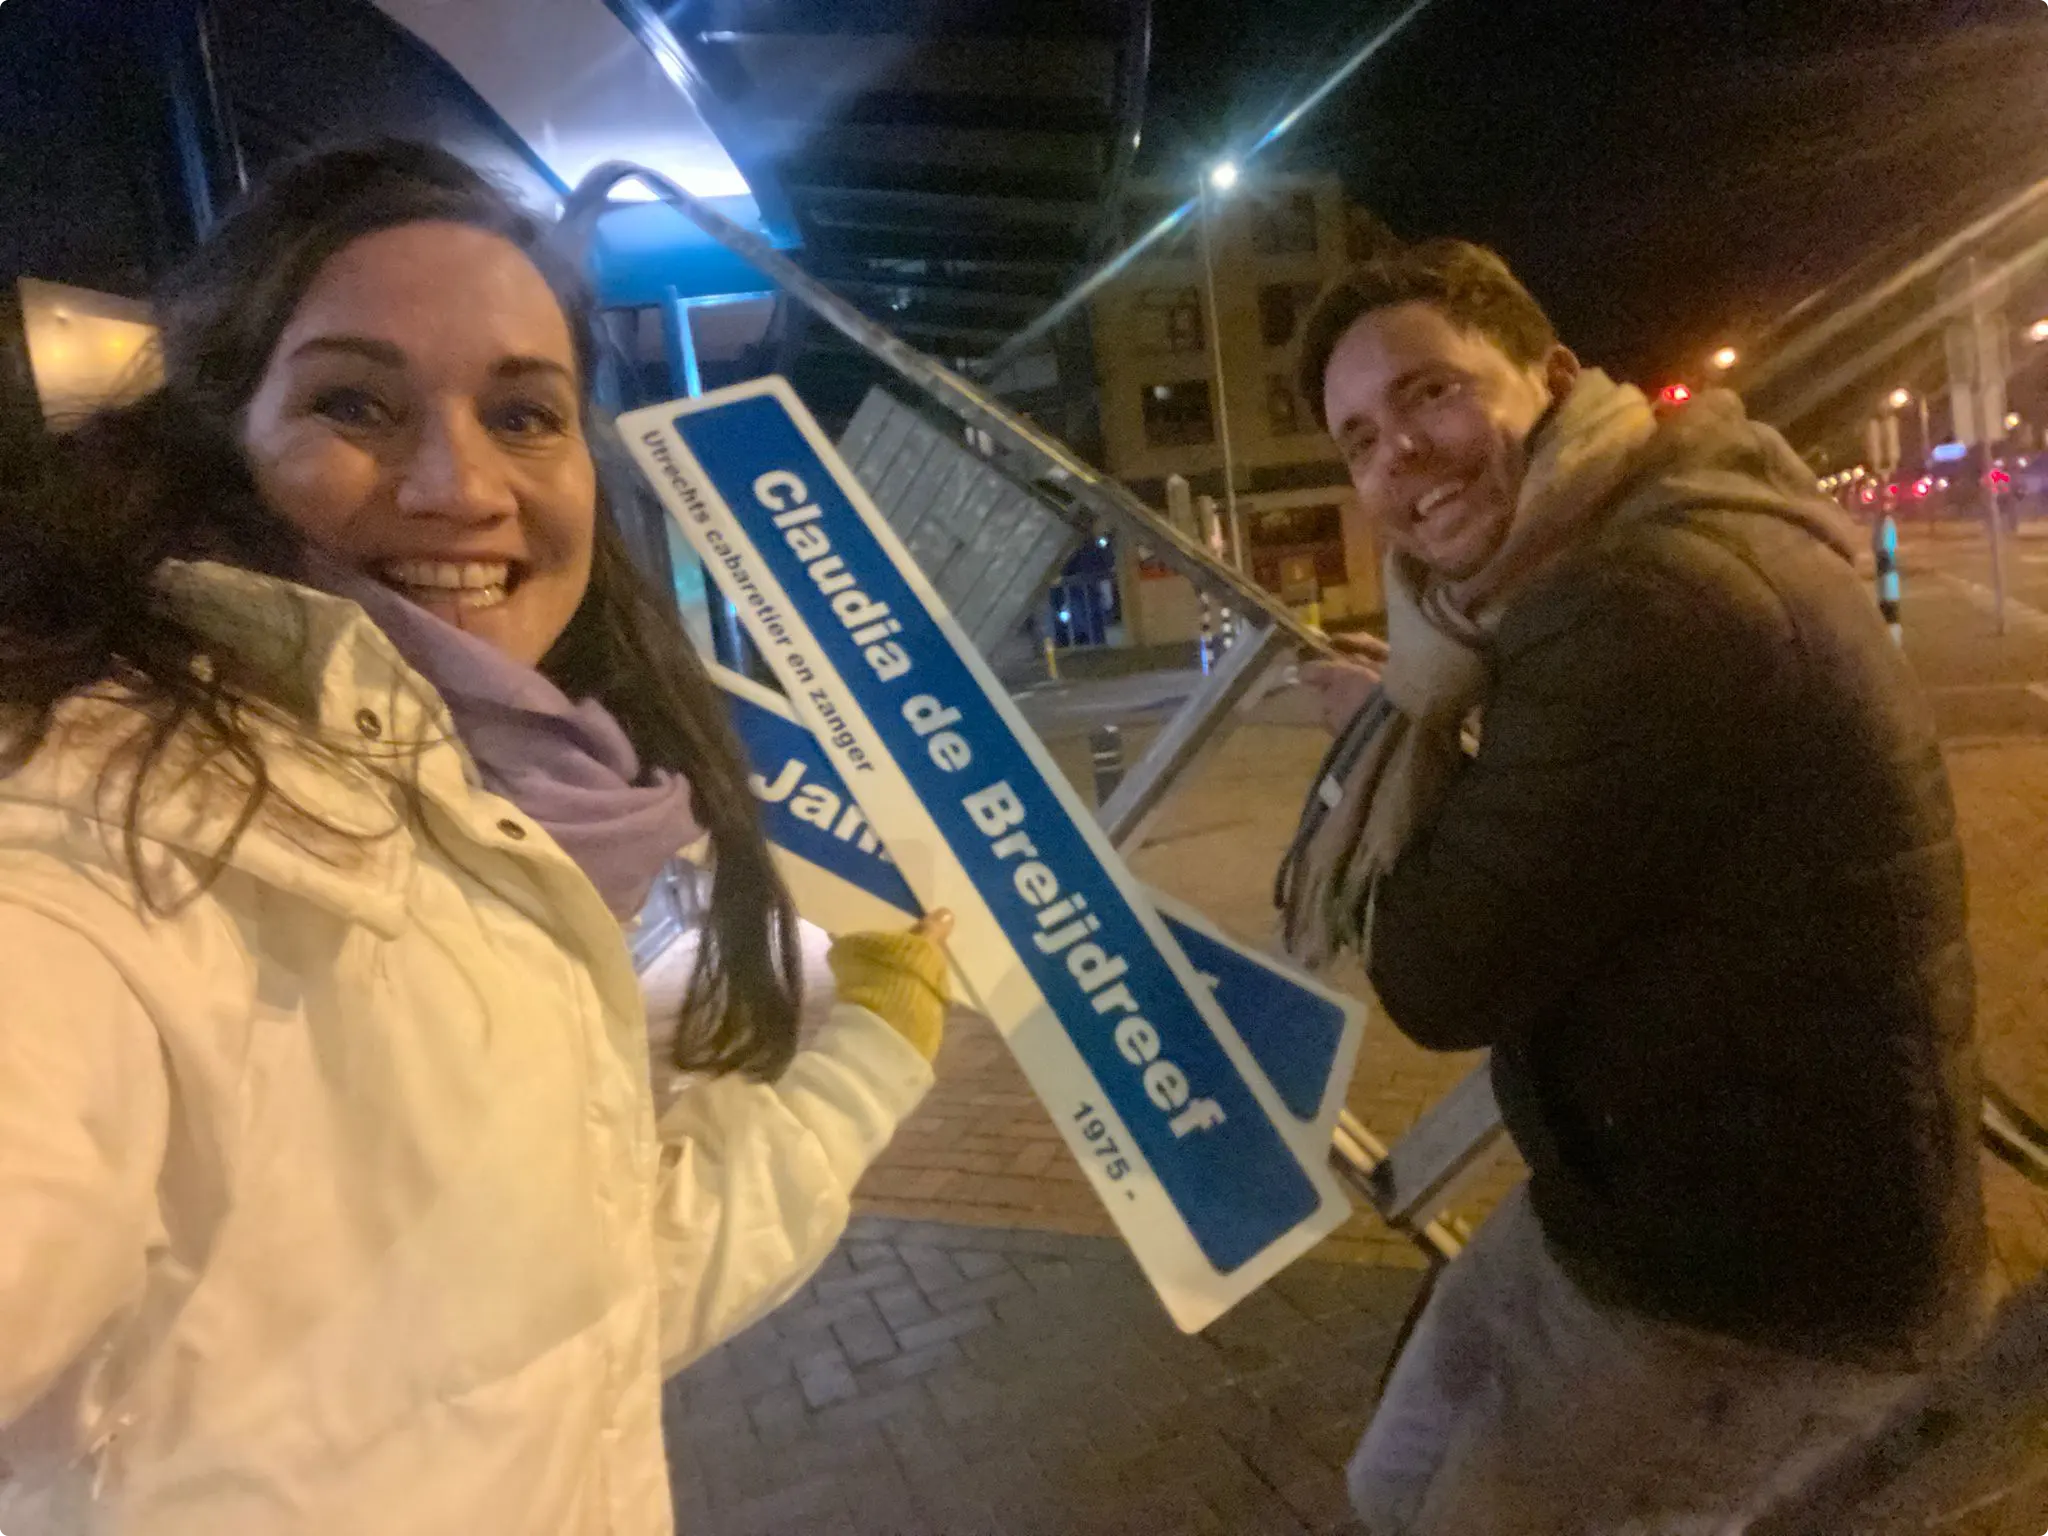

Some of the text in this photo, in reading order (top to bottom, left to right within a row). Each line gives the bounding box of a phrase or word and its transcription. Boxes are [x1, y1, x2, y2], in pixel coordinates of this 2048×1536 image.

[643, 429, 875, 773] Utrechts cabaretier en zanger
[748, 758, 893, 864] Jan
[753, 470, 1225, 1138] Claudia de Breijdreef
[1072, 1103, 1130, 1181] 1975
